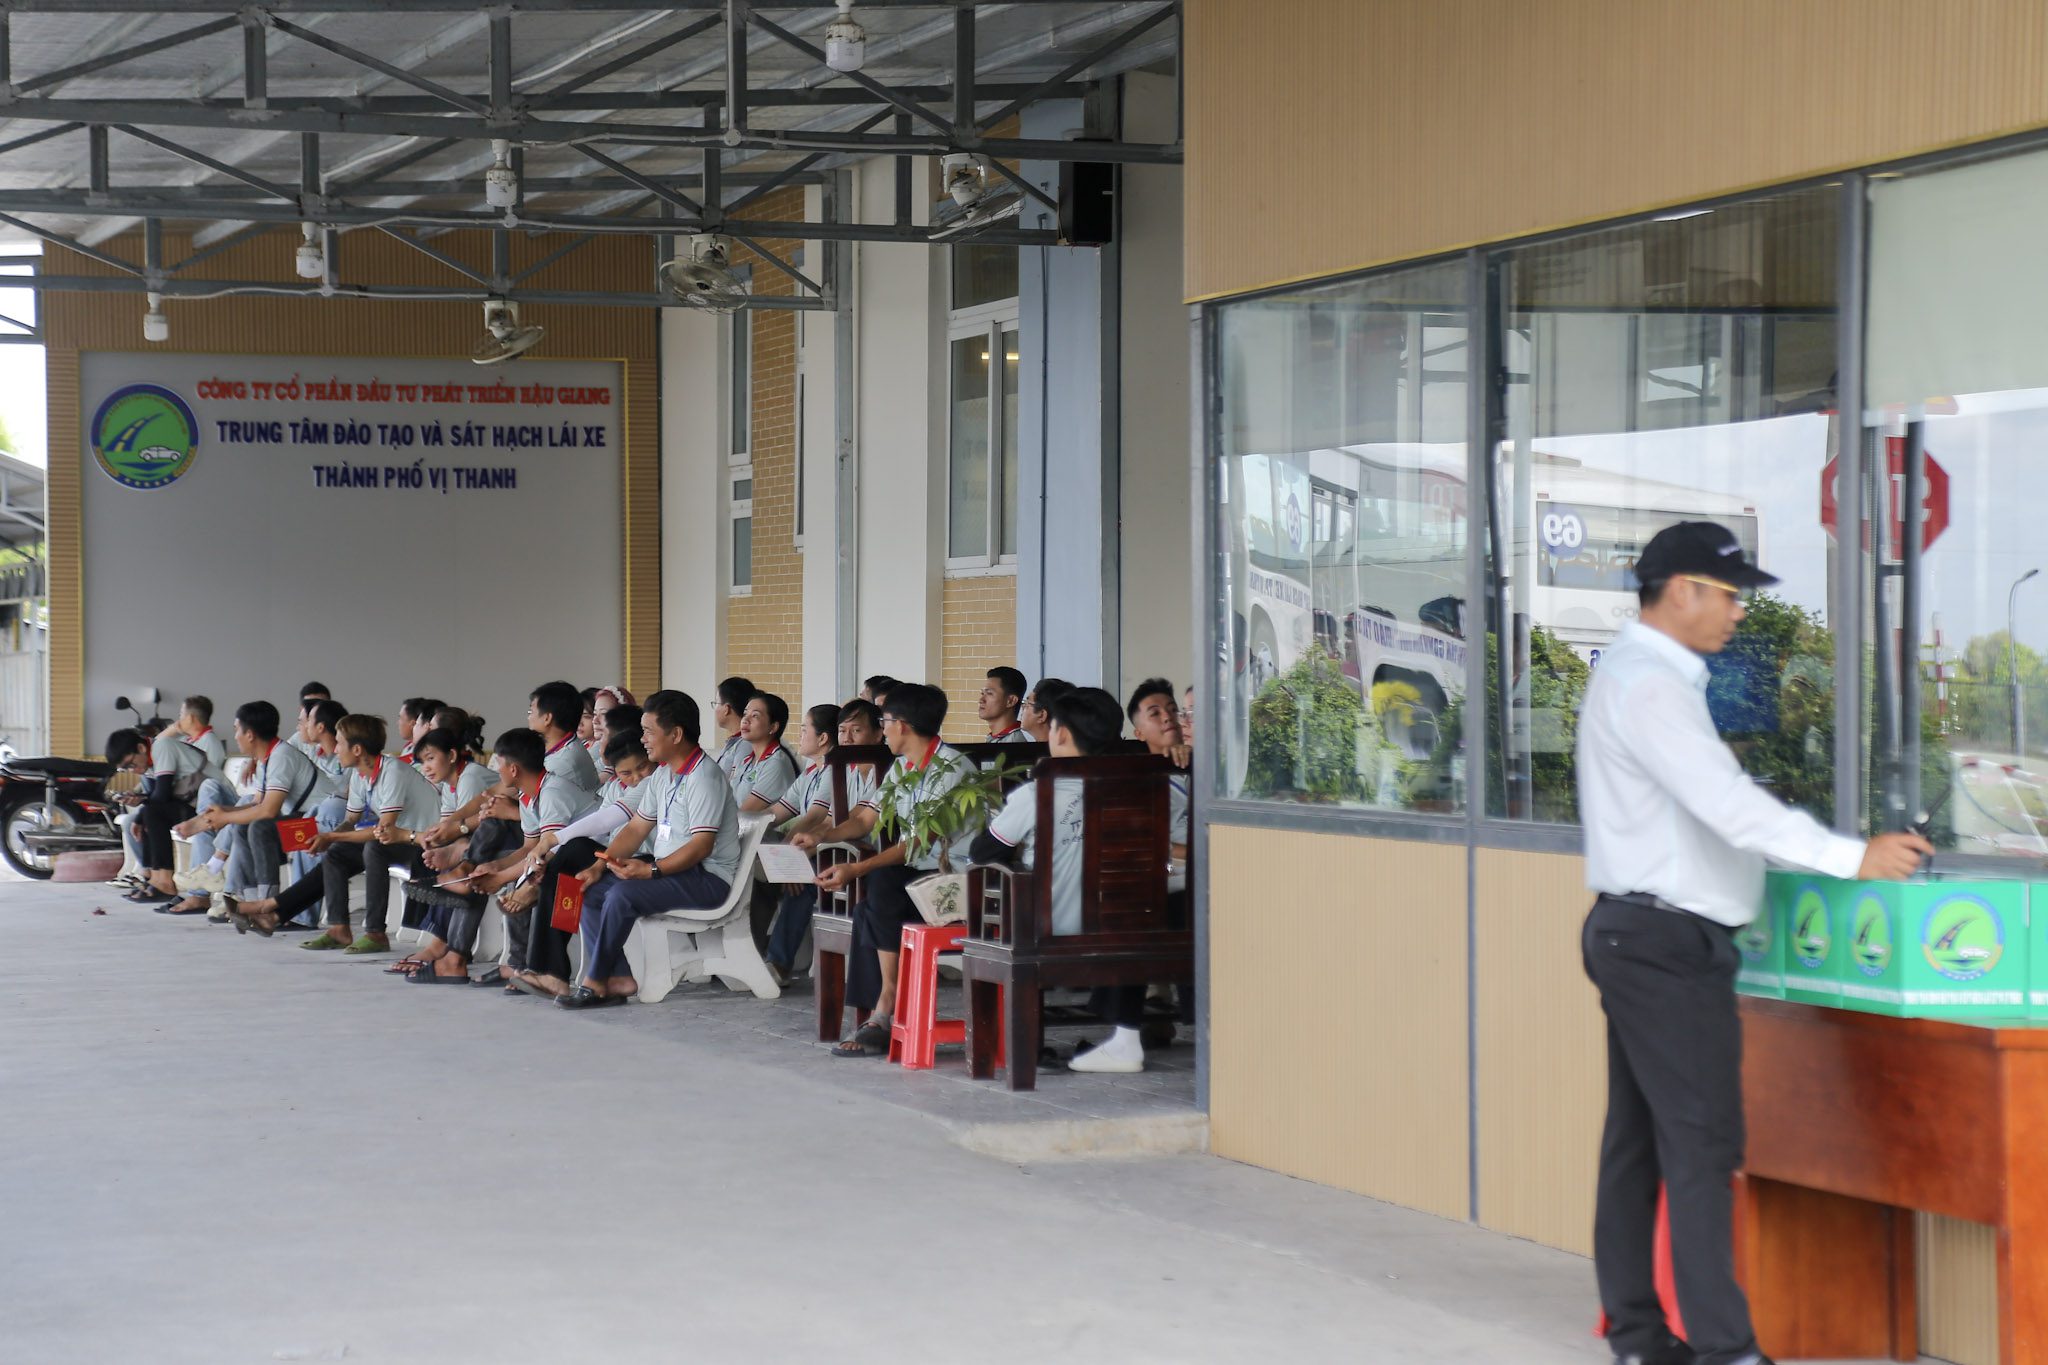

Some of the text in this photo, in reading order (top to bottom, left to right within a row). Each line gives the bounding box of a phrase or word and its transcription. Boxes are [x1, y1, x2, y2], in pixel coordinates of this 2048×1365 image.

[197, 376, 247, 400] CÔNG
[251, 382, 272, 400] TY
[422, 381, 464, 404] PHÁT
[557, 386, 611, 405] GIANG
[216, 417, 606, 452] TRUNG TÂM ĐÀO TẠO VÀ SÁT HẠCH LÁI XE
[312, 457, 517, 494] THÀNH PHỐ VỊ THANH
